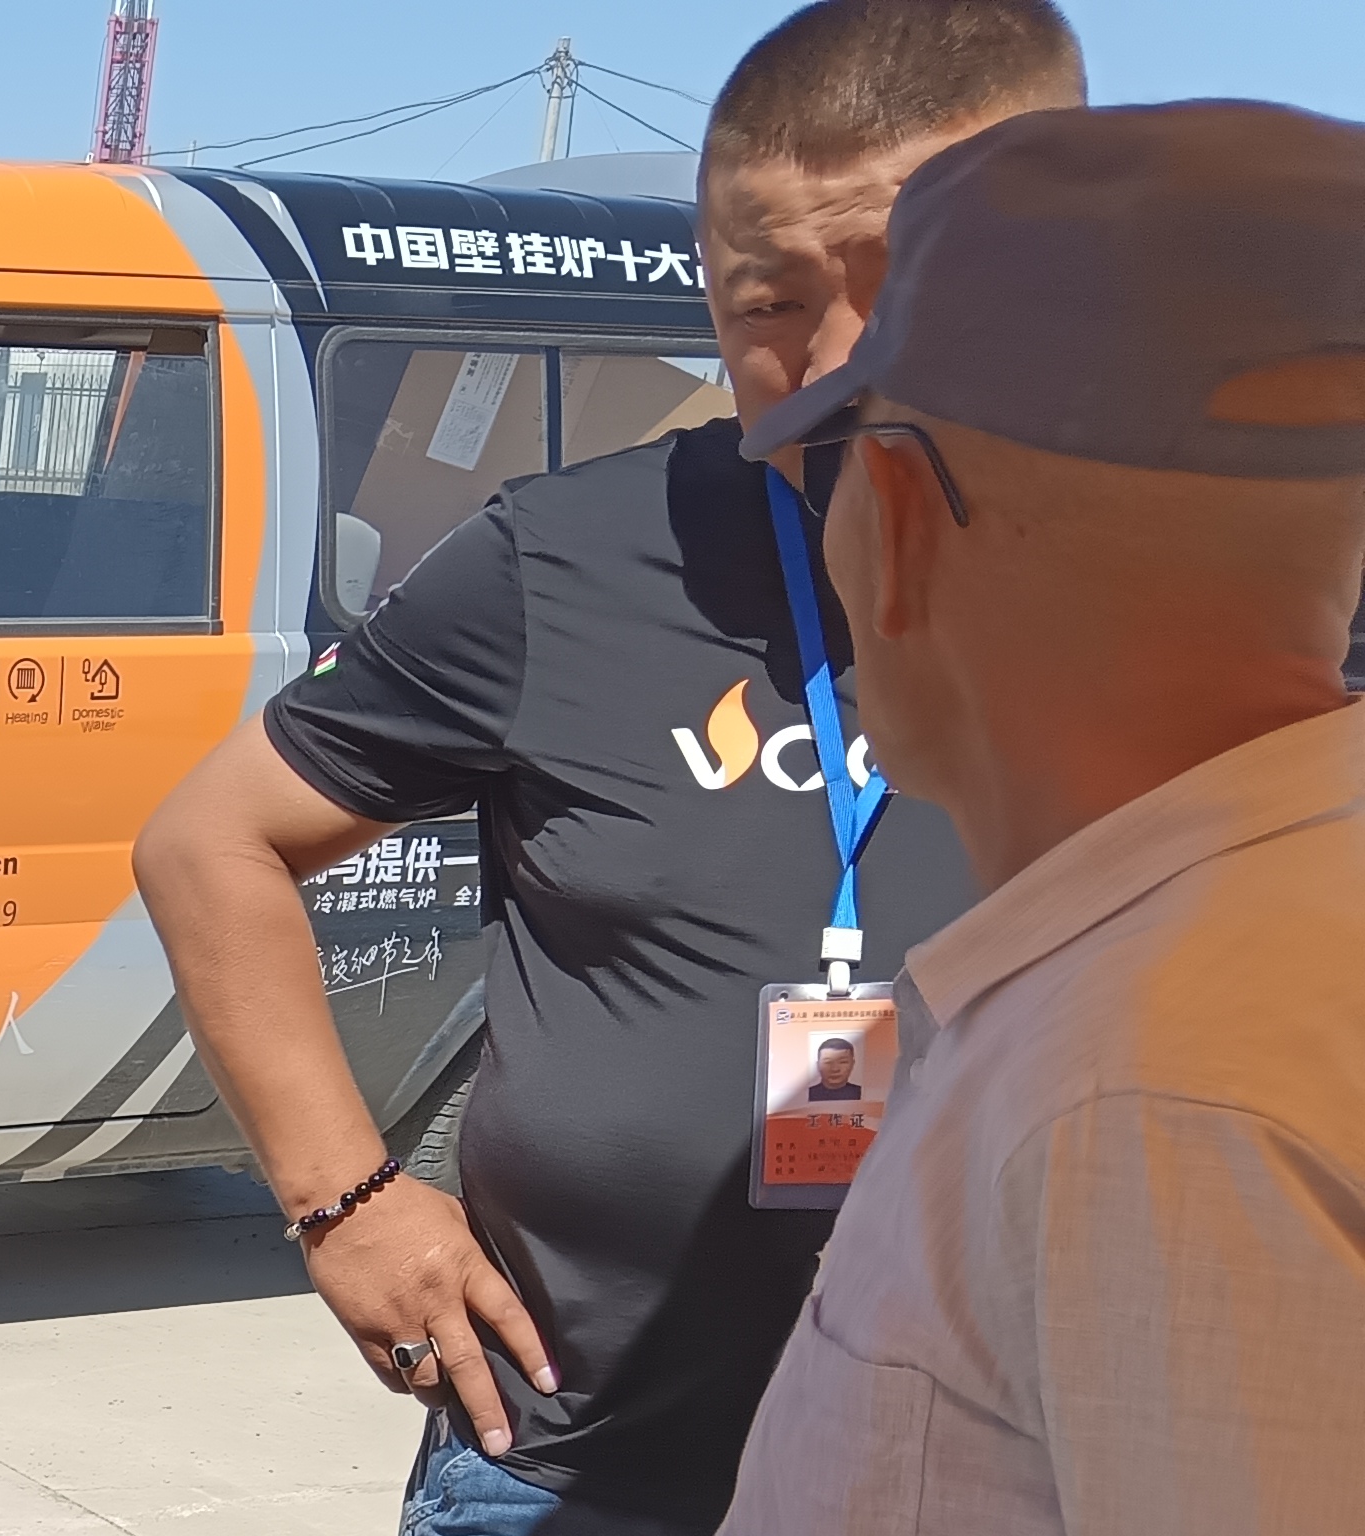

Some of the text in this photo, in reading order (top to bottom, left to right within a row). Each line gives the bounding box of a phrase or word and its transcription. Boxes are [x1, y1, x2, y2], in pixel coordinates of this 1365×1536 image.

[341, 222, 706, 289] 中国壁挂炉十大
[4, 710, 49, 725] Heating
[72, 706, 125, 721] Domestic
[81, 719, 116, 732] Water
[301, 836, 480, 887] 马提供一
[313, 888, 437, 914] 冷凝式燃气炉
[807, 1112, 865, 1128] 工作证
